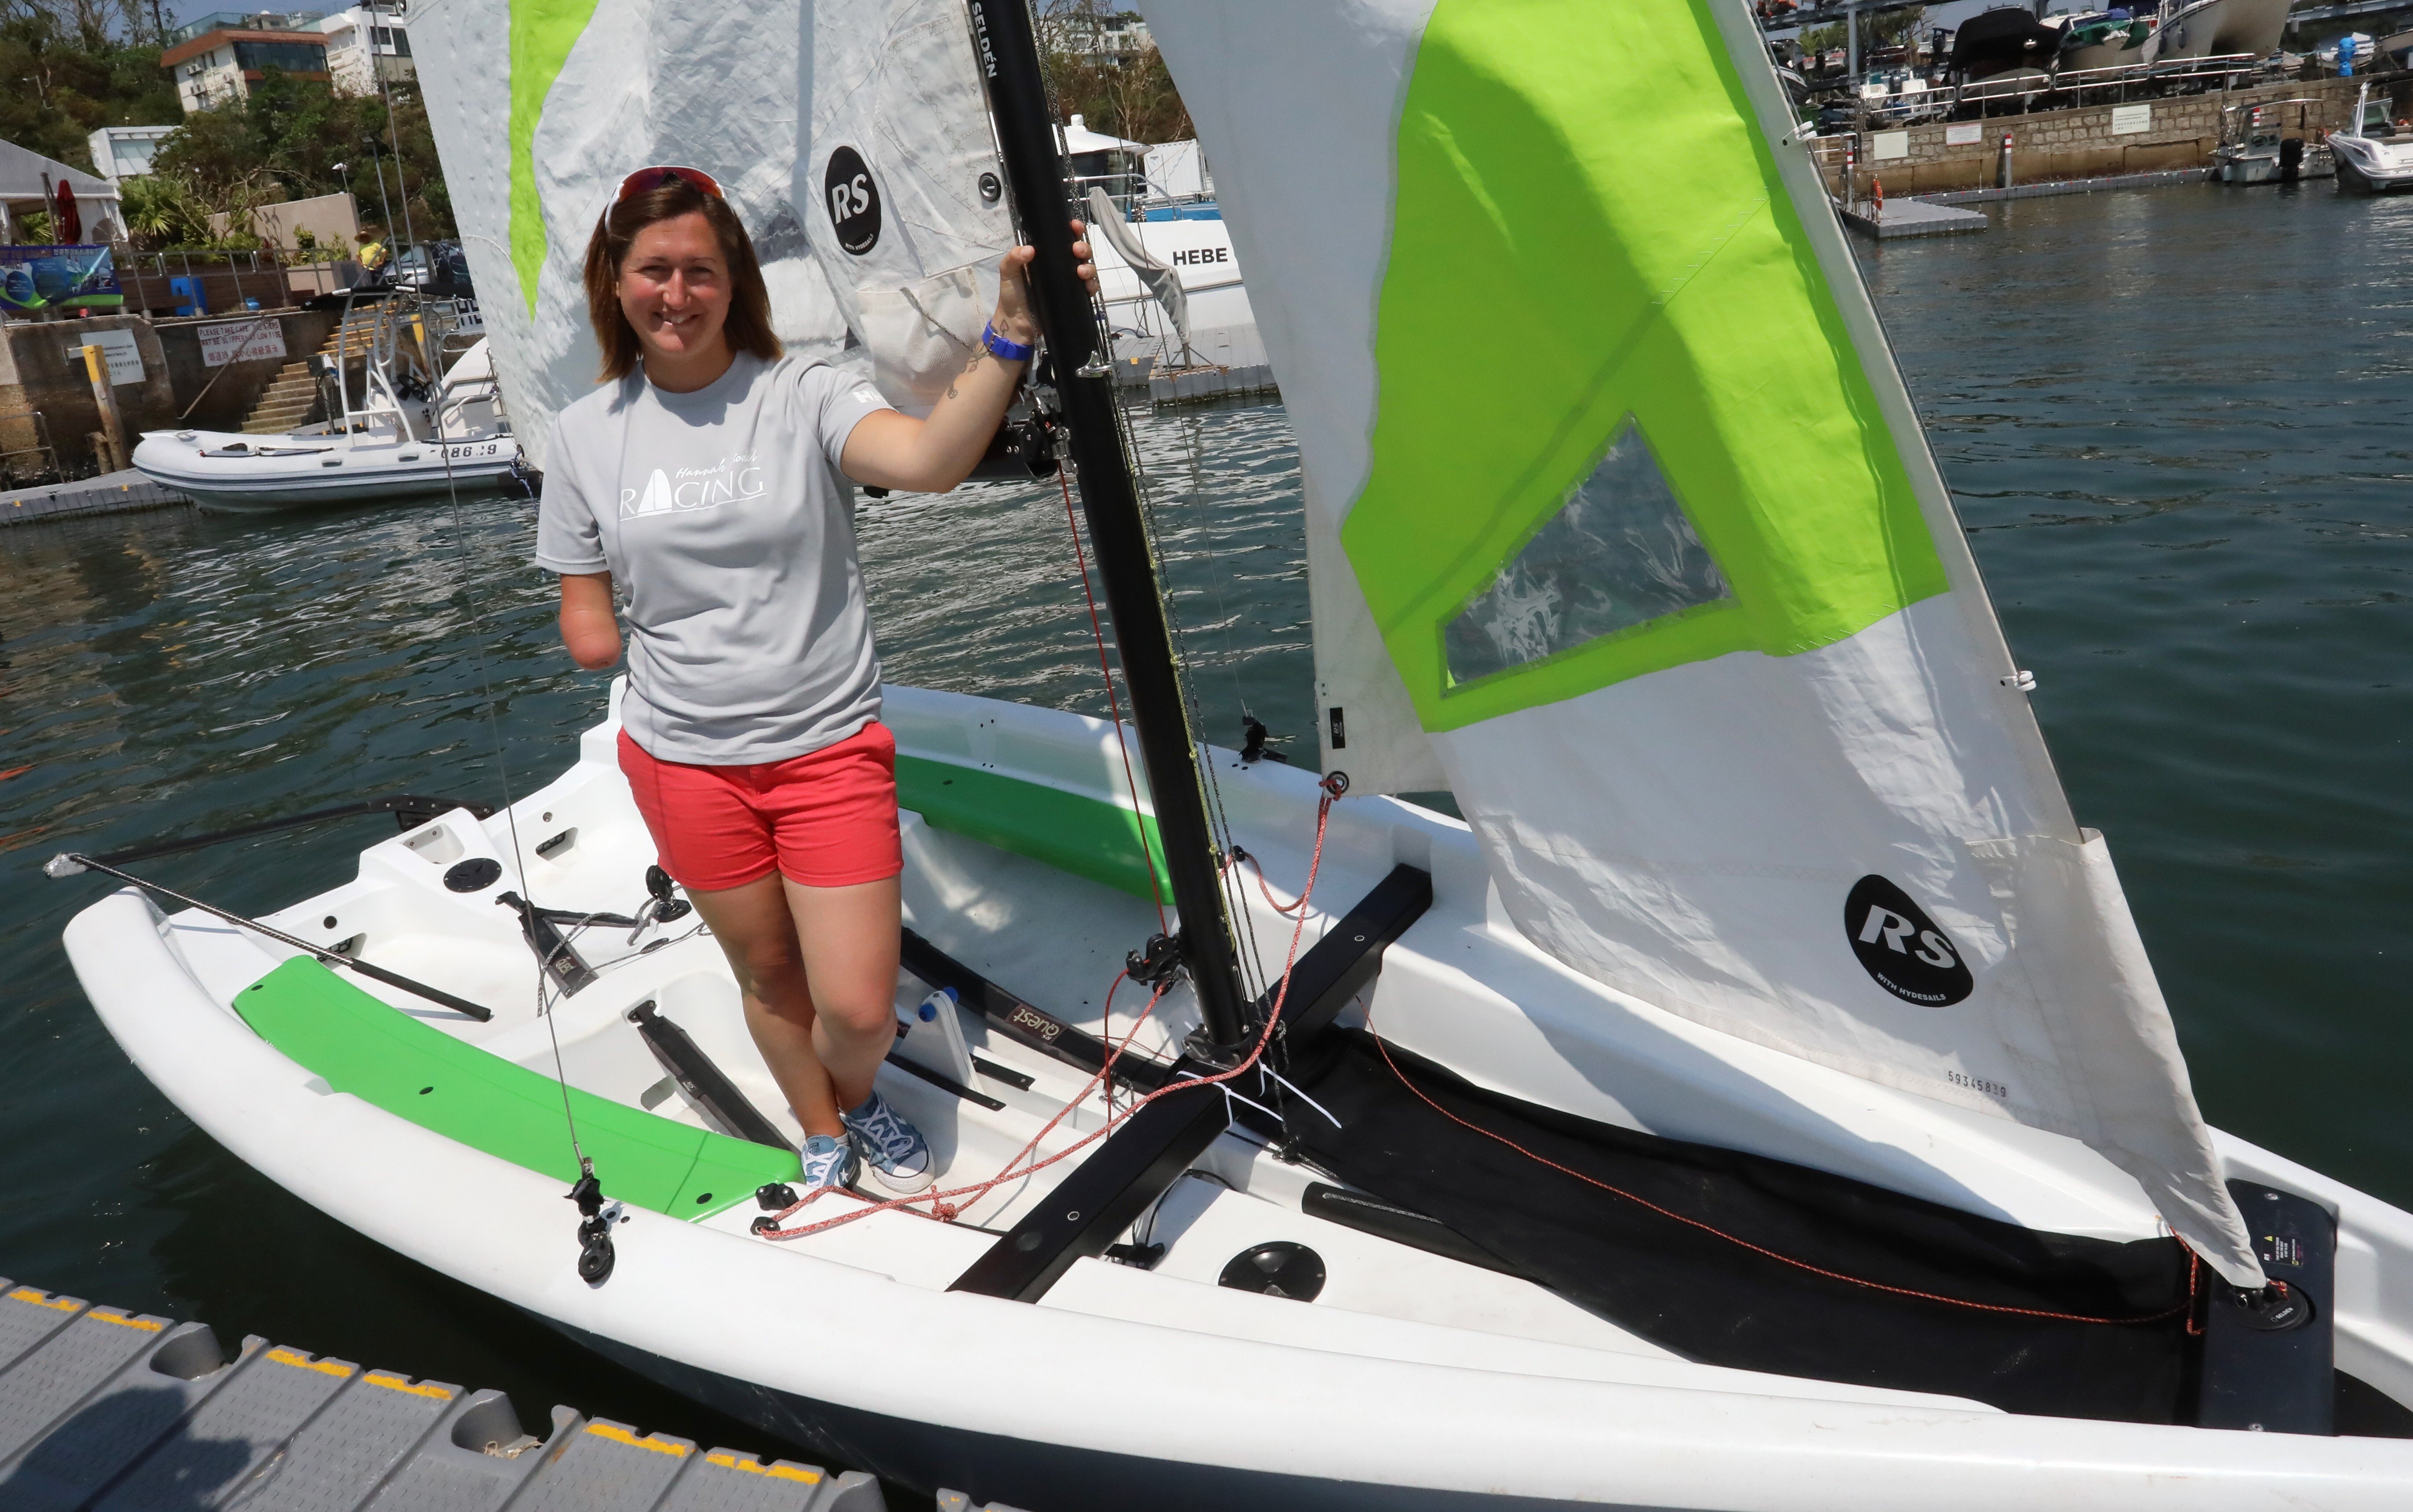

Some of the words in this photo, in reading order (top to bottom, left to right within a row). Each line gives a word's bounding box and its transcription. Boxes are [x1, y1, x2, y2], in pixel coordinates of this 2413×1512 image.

[972, 2, 997, 78] SELDÉN
[832, 173, 869, 225] RS
[1172, 247, 1228, 266] HEBE
[199, 328, 219, 336] PLEASE
[675, 458, 726, 478] Hannah
[1858, 904, 1956, 968] RS
[1877, 972, 1898, 990] WITH
[1899, 987, 1946, 1001] HYDESAILS
[1013, 1008, 1060, 1036] Quest
[1948, 1070, 2006, 1097] 59345839
[2263, 1253, 2270, 1261] RS
